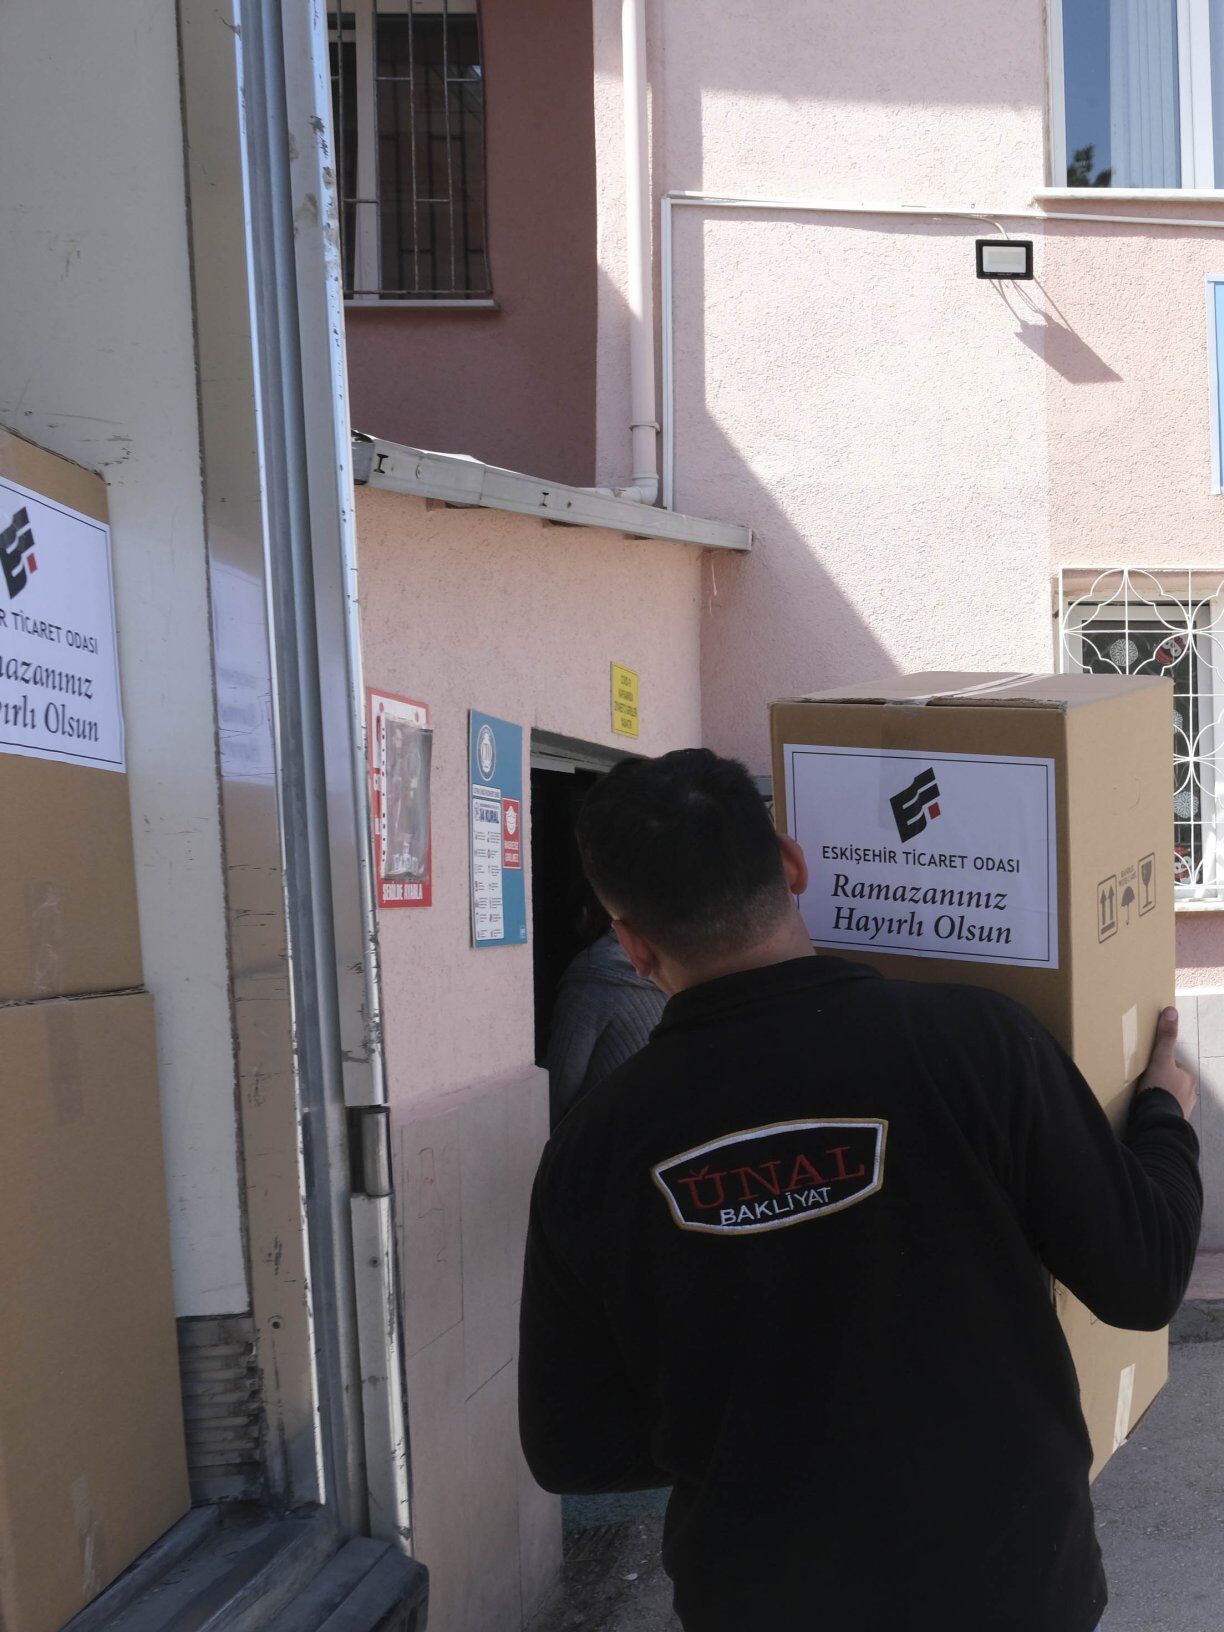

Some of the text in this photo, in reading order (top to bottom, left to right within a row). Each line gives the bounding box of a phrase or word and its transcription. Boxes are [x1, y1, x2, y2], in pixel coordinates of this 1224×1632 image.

[11, 610, 62, 645] TİCARET
[65, 629, 98, 655] ODASI
[44, 701, 99, 743] Olsun
[822, 845, 1020, 873] ESKİŞEHİR TİCARET ODASI
[831, 873, 1008, 911] Ramazanınız
[832, 906, 1012, 945] Hayırlı Olsun
[677, 1146, 866, 1209] ÜNAL
[719, 1187, 831, 1227] BAKLİYAT
